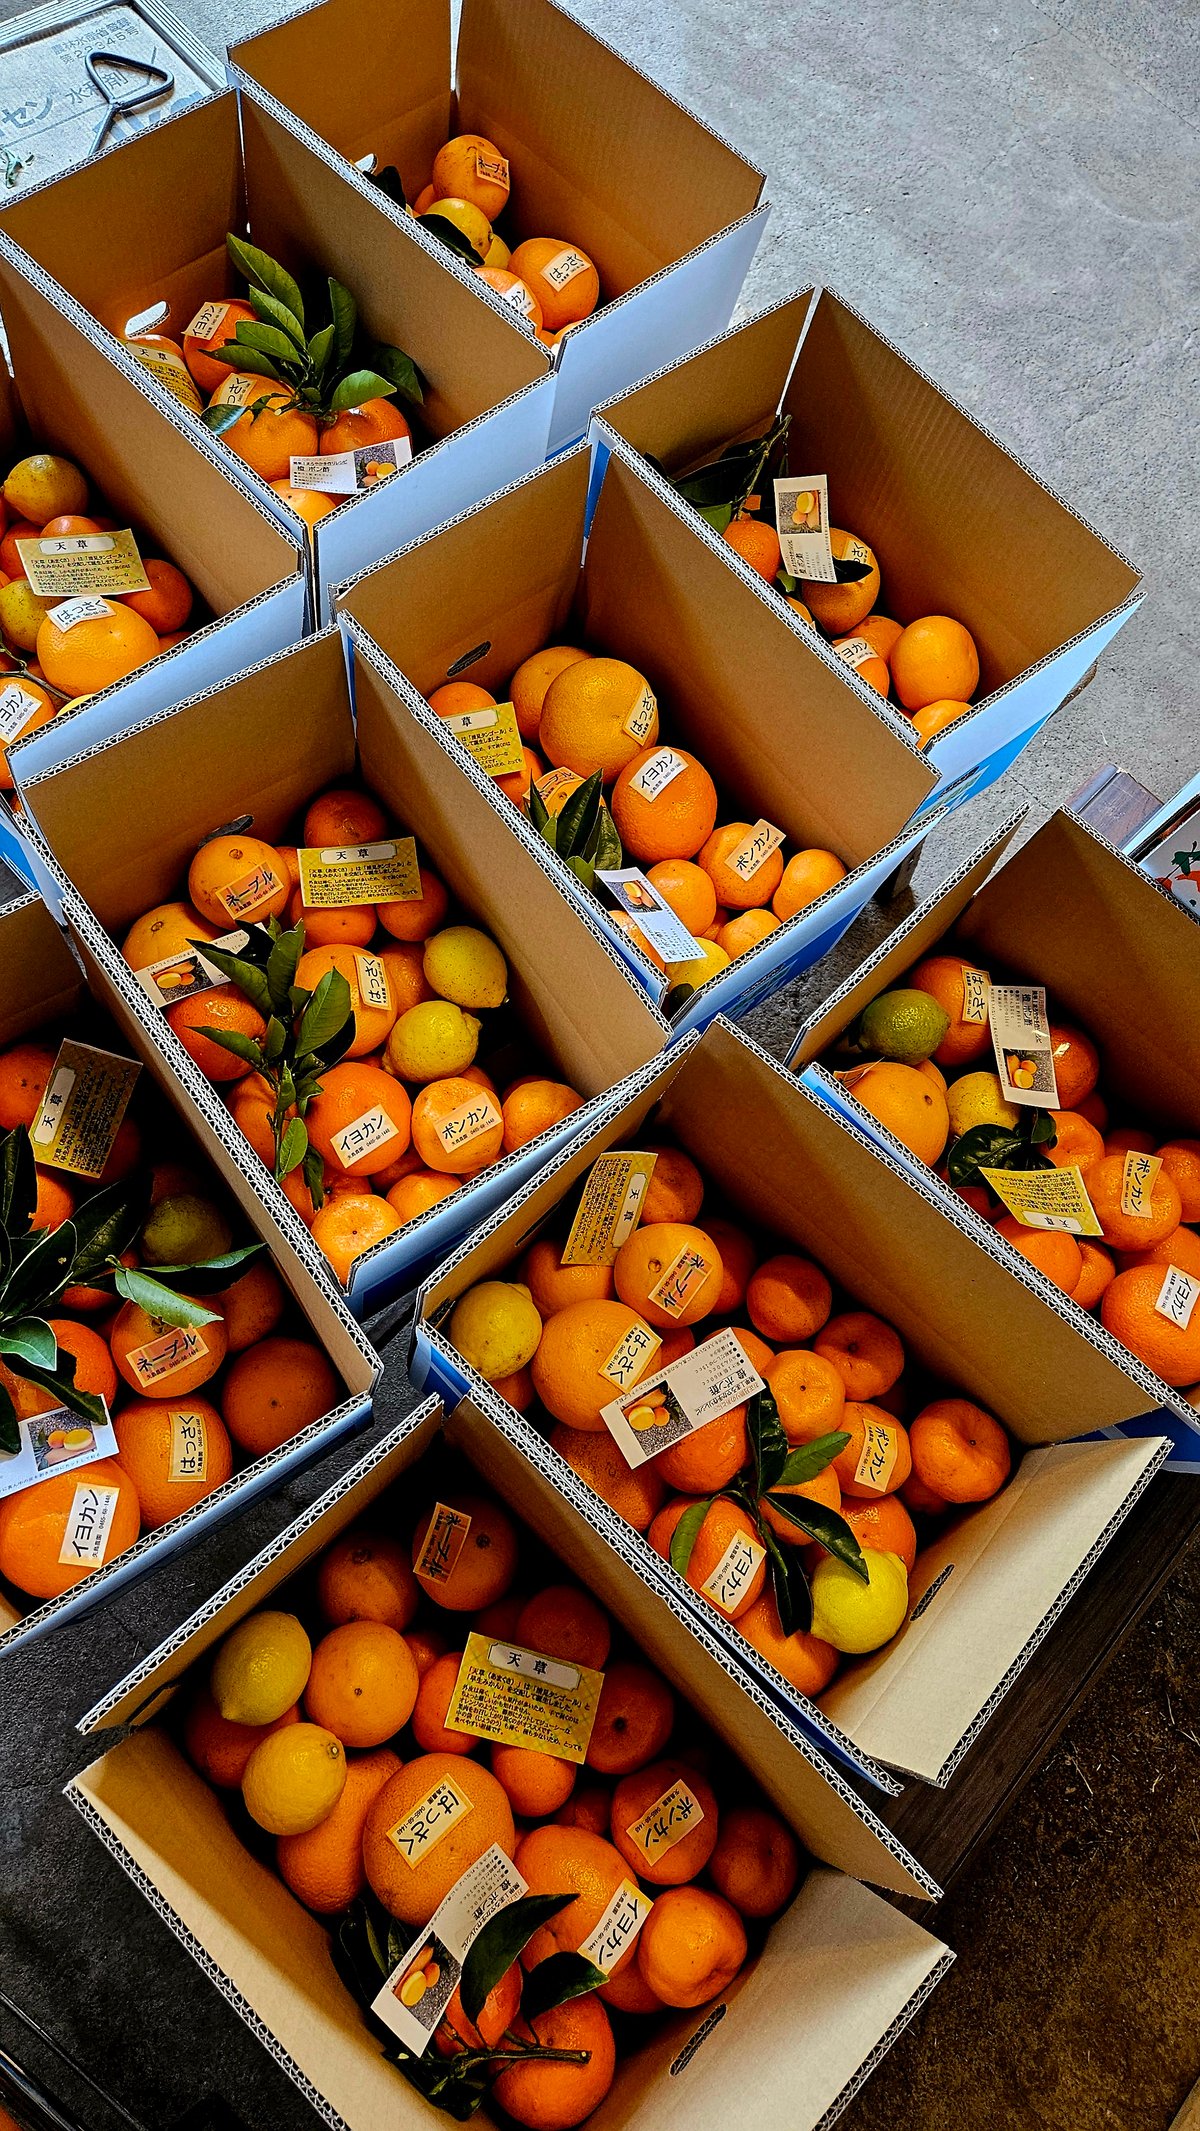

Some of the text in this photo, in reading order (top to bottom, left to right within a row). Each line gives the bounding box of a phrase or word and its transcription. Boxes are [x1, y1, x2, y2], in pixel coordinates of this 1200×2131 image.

[549, 253, 582, 281] はっさく
[511, 288, 527, 308] カン
[192, 305, 214, 335] イヨカン
[227, 377, 249, 404] っさく
[54, 539, 88, 551] 天草
[851, 541, 865, 562] さく
[56, 599, 106, 622] はっさく
[841, 642, 868, 660] ヨカン
[630, 688, 652, 735] はっさく
[538, 771, 575, 793] ーブル
[640, 753, 673, 789] イヨカン
[335, 849, 369, 861] 天草
[736, 828, 769, 870] ポンカン
[225, 871, 272, 906] ネーブル
[362, 957, 381, 1003] はっさく
[970, 972, 984, 1019] はっさく
[42, 1093, 63, 1129] 天草
[442, 1106, 487, 1138] ポンカン
[340, 1115, 382, 1150] イヨカン
[1130, 1158, 1150, 1211] ポンカン
[624, 1188, 640, 1222] 天草
[664, 1254, 704, 1307] ネーブル
[1171, 1278, 1191, 1319] イヨカン
[137, 1334, 196, 1371] ネーブル
[610, 1330, 650, 1383] はっさく
[178, 1415, 196, 1473] はっさく
[869, 1426, 889, 1481] ポンカン
[72, 1489, 98, 1556] イヨカン
[427, 1512, 461, 1578] ネーブル
[721, 1547, 752, 1602] イヨカン
[505, 1650, 549, 1677] 天草
[398, 1790, 458, 1854] はっさく
[645, 1796, 693, 1846] ポンカン
[598, 1899, 637, 1964] イヨカン
